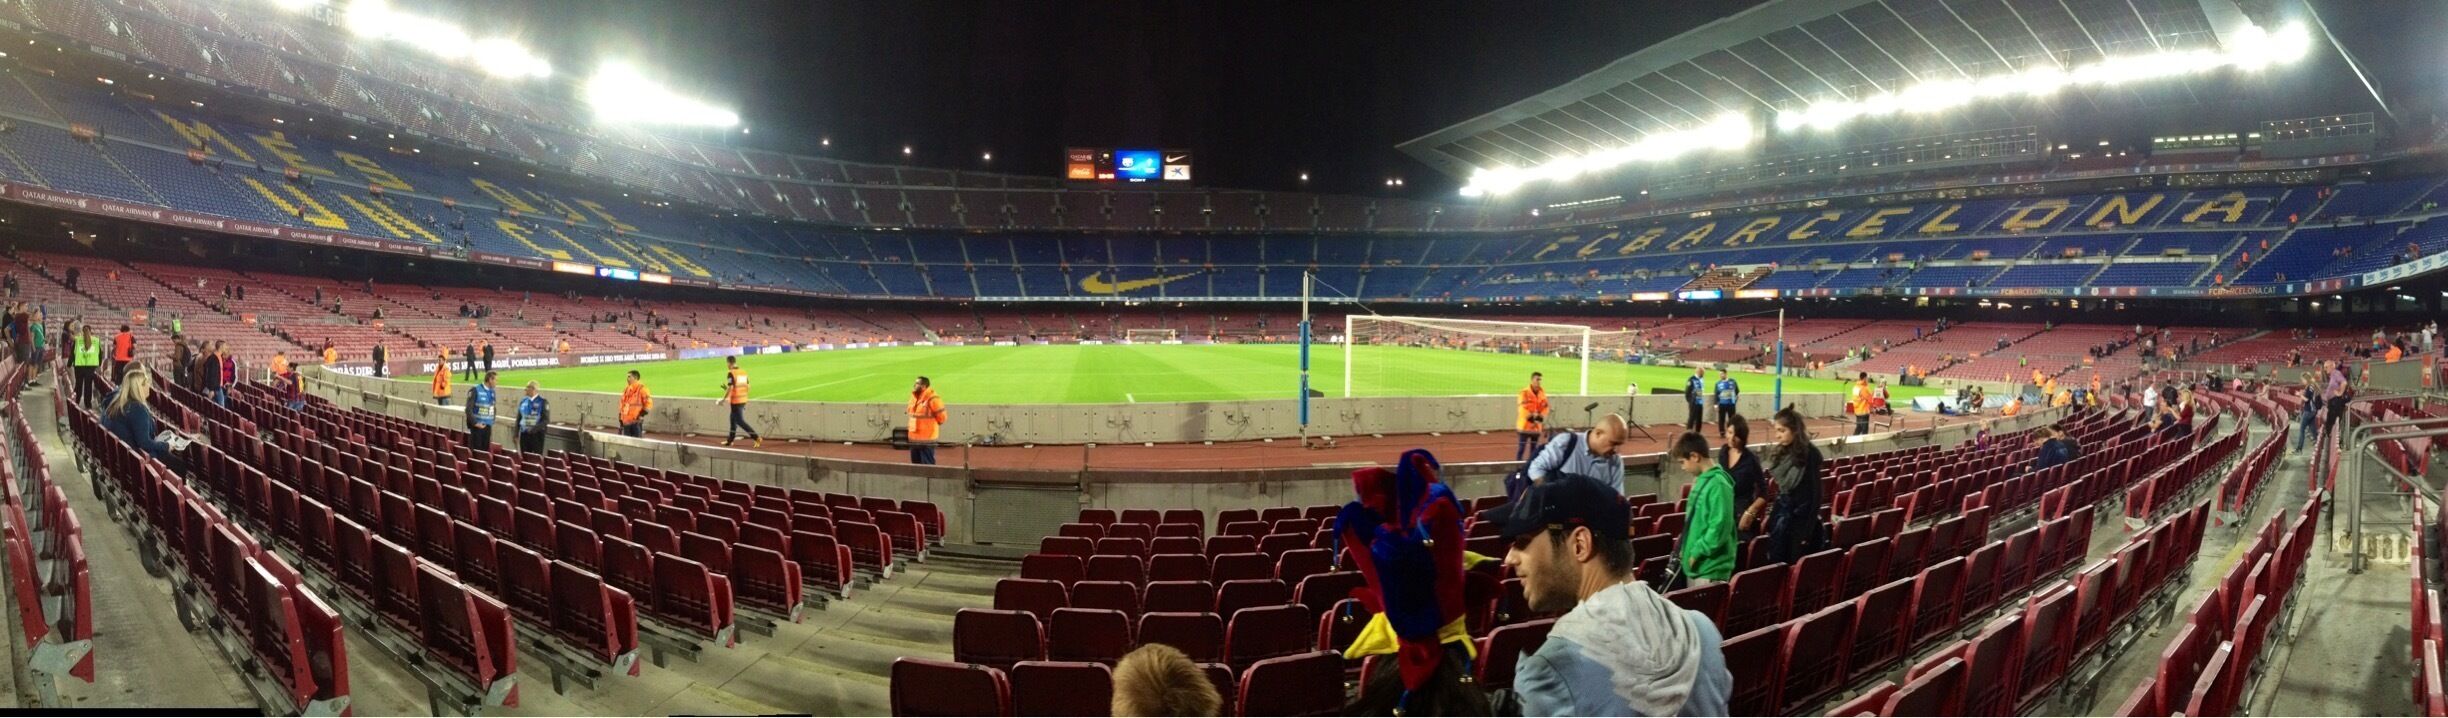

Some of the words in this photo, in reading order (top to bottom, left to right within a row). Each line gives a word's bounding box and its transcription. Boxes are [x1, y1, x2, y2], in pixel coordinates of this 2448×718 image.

[22, 190, 46, 201] QATAR
[47, 195, 77, 206] AIRWAYS
[102, 204, 124, 214] QATAR
[125, 208, 152, 218] AIRWAYS
[172, 214, 192, 224] QATAR
[193, 217, 217, 227] AIRWAYS
[234, 223, 252, 232] QATAR
[252, 226, 273, 235] AIRWAYS
[290, 231, 307, 239] QATAR
[355, 366, 391, 376] DIR-O.
[452, 361, 460, 370] SI
